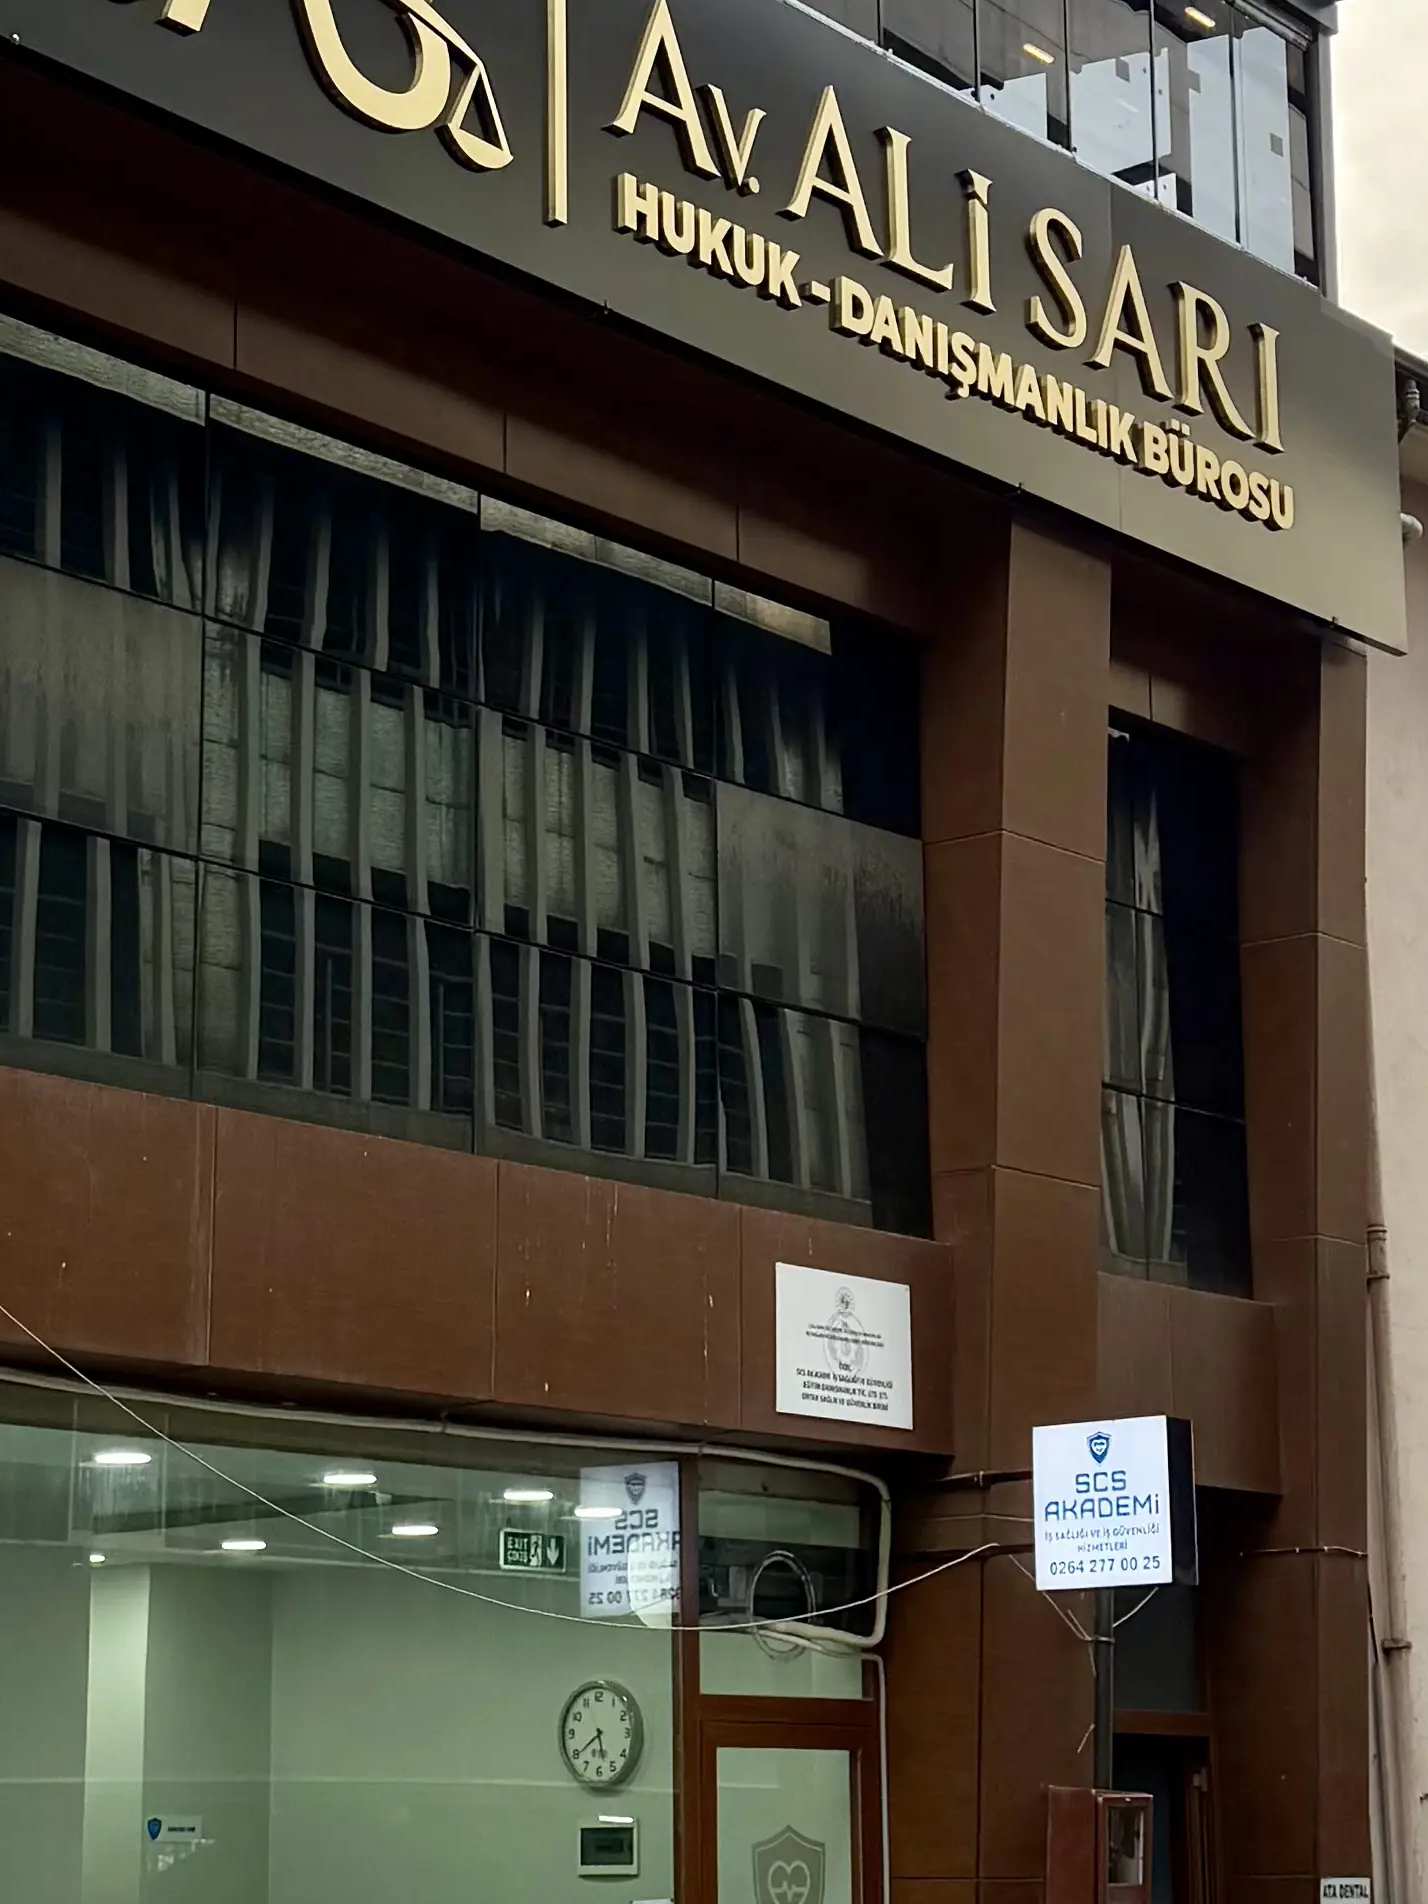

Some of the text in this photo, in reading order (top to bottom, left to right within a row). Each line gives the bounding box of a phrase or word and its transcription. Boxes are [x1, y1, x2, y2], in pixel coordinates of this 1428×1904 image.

[776, 85, 997, 315] ALİ
[1025, 207, 1285, 454] SARI
[617, 172, 802, 309] HUKUK
[829, 275, 1138, 466] DANIŞMANLIK
[1136, 419, 1295, 532] BÜROSU
[1075, 1470, 1126, 1493] SCS
[1045, 1494, 1159, 1521] AKADEMİ
[1050, 1555, 1160, 1575] 0264 277 00 25
